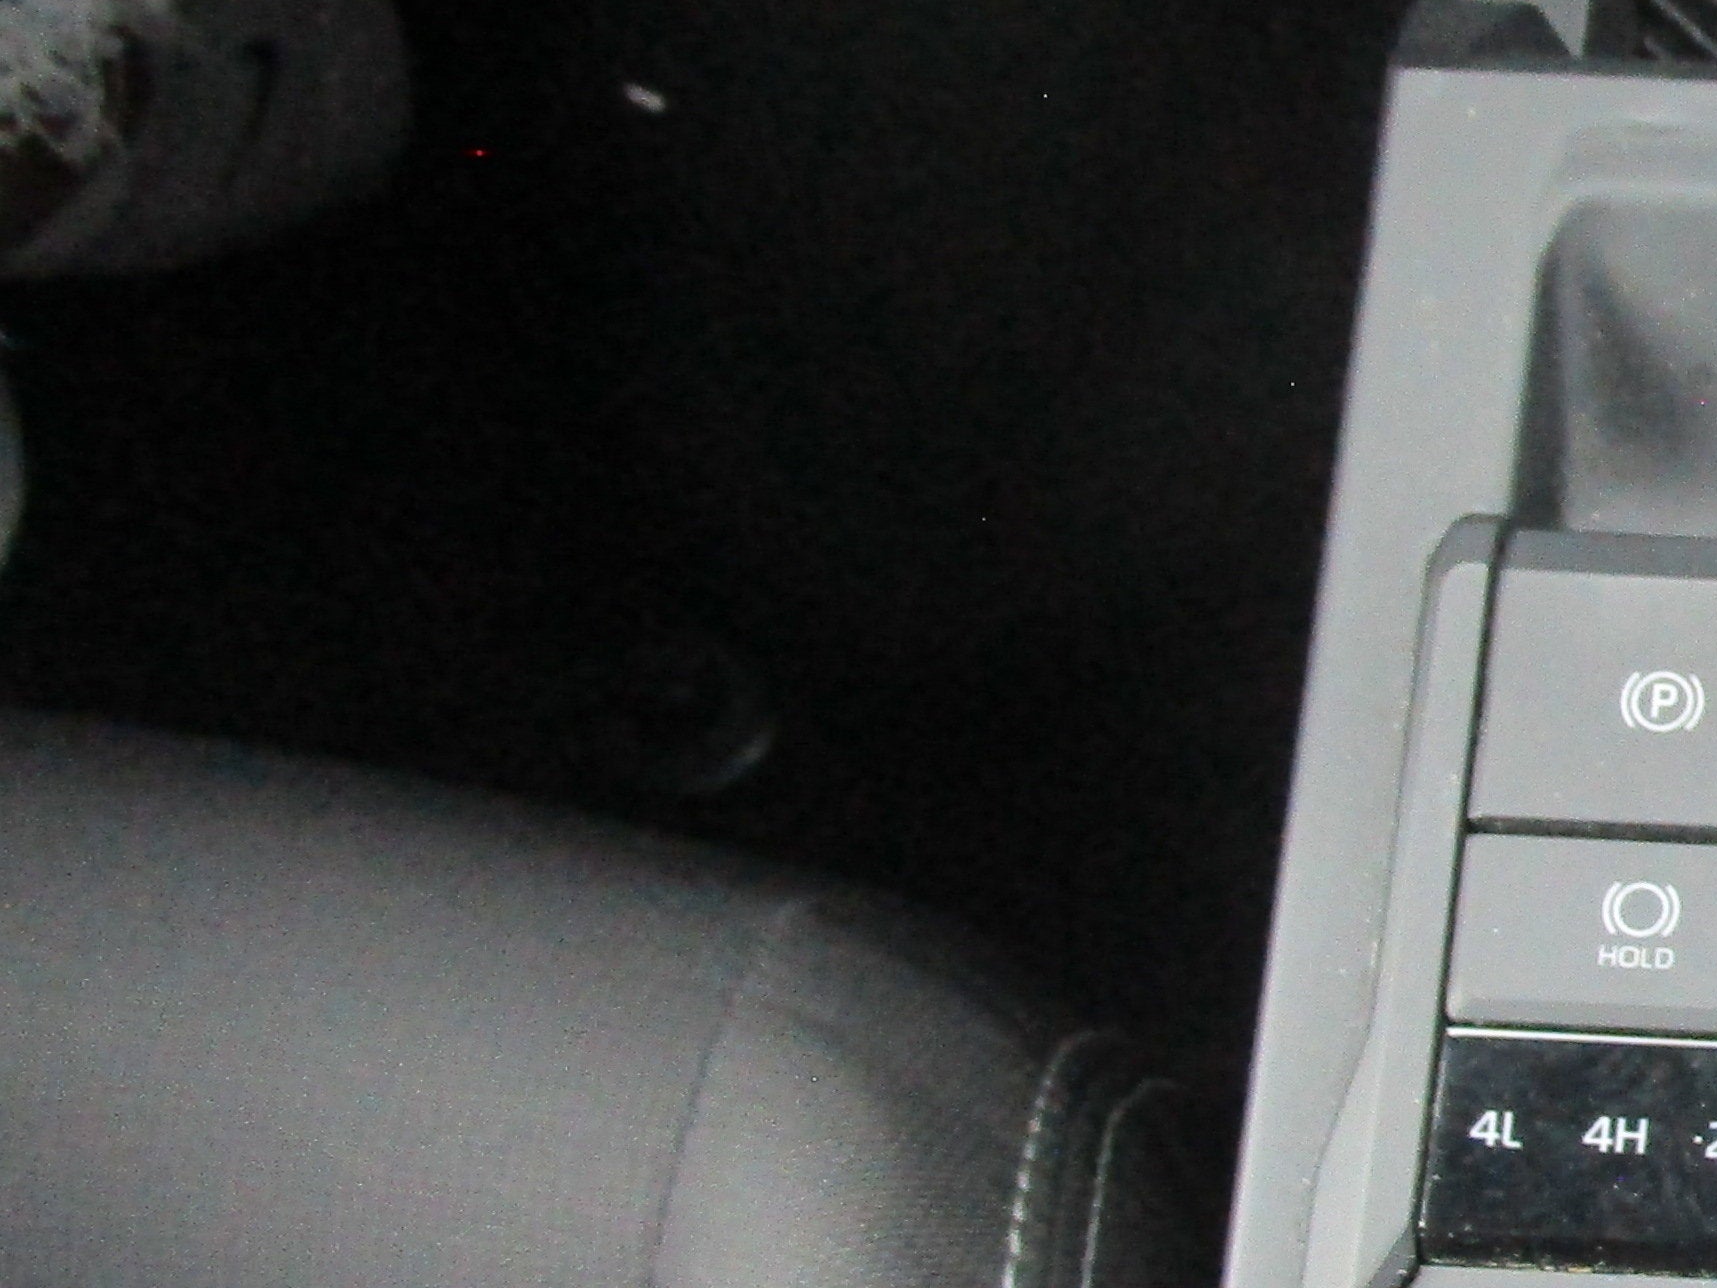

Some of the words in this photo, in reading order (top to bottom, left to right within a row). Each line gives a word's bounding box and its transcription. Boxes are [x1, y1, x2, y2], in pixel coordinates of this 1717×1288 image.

[1597, 944, 1674, 970] HOLD
[1468, 1109, 1524, 1150] 4L
[1581, 1114, 1648, 1155] 4H
